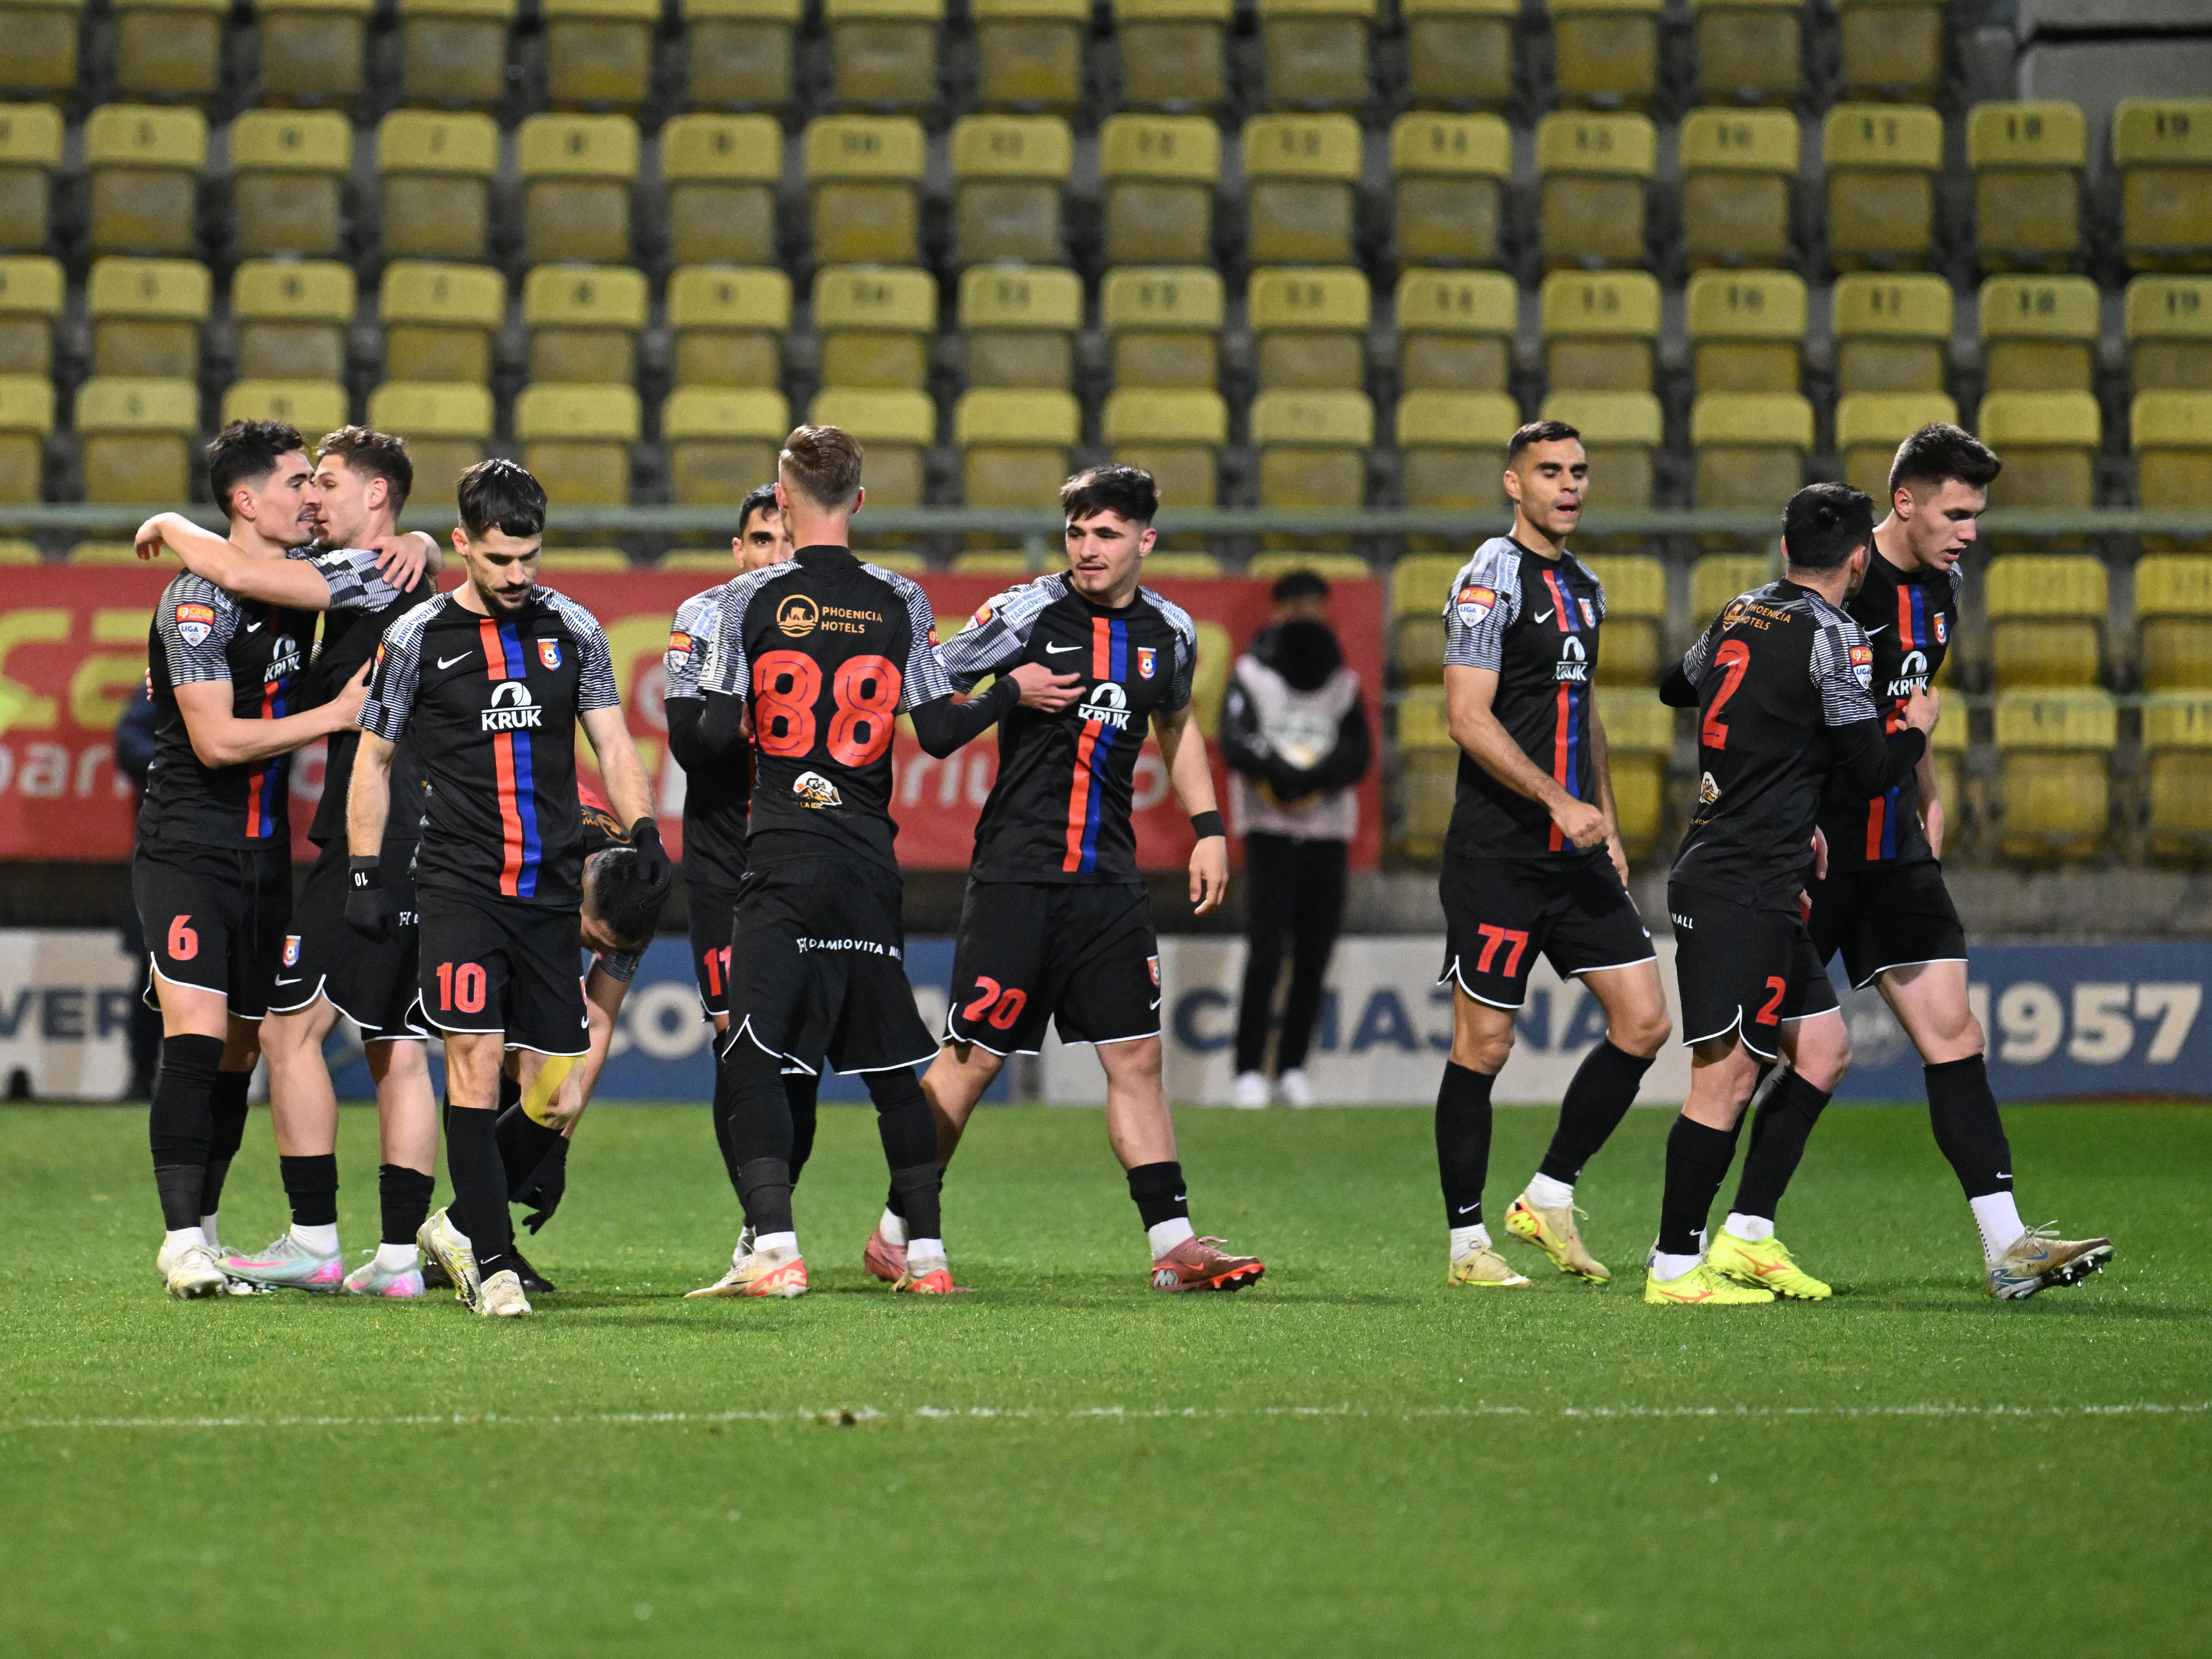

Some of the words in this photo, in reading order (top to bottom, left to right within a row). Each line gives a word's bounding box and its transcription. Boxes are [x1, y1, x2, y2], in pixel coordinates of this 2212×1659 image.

[822, 606, 883, 623] PHOENICIA
[1739, 616, 1771, 630] HOTELS
[1747, 604, 1791, 623] PHOENICIA
[821, 621, 865, 634] HOTELS
[265, 655, 300, 682] KRUK
[1553, 664, 1587, 681] KRUK
[1703, 639, 1750, 750] 2
[480, 711, 542, 729] KRUK
[753, 650, 902, 767] 88
[1079, 705, 1131, 731] KRUK
[1672, 912, 1693, 929] MALL
[168, 915, 198, 961] 6
[809, 938, 884, 955] DAMBOVITA
[1475, 923, 1529, 977] 77
[437, 962, 487, 1013] 10
[963, 975, 1027, 1030] 20
[1755, 976, 1786, 1027] 2
[1970, 981, 2202, 1065] 1957
